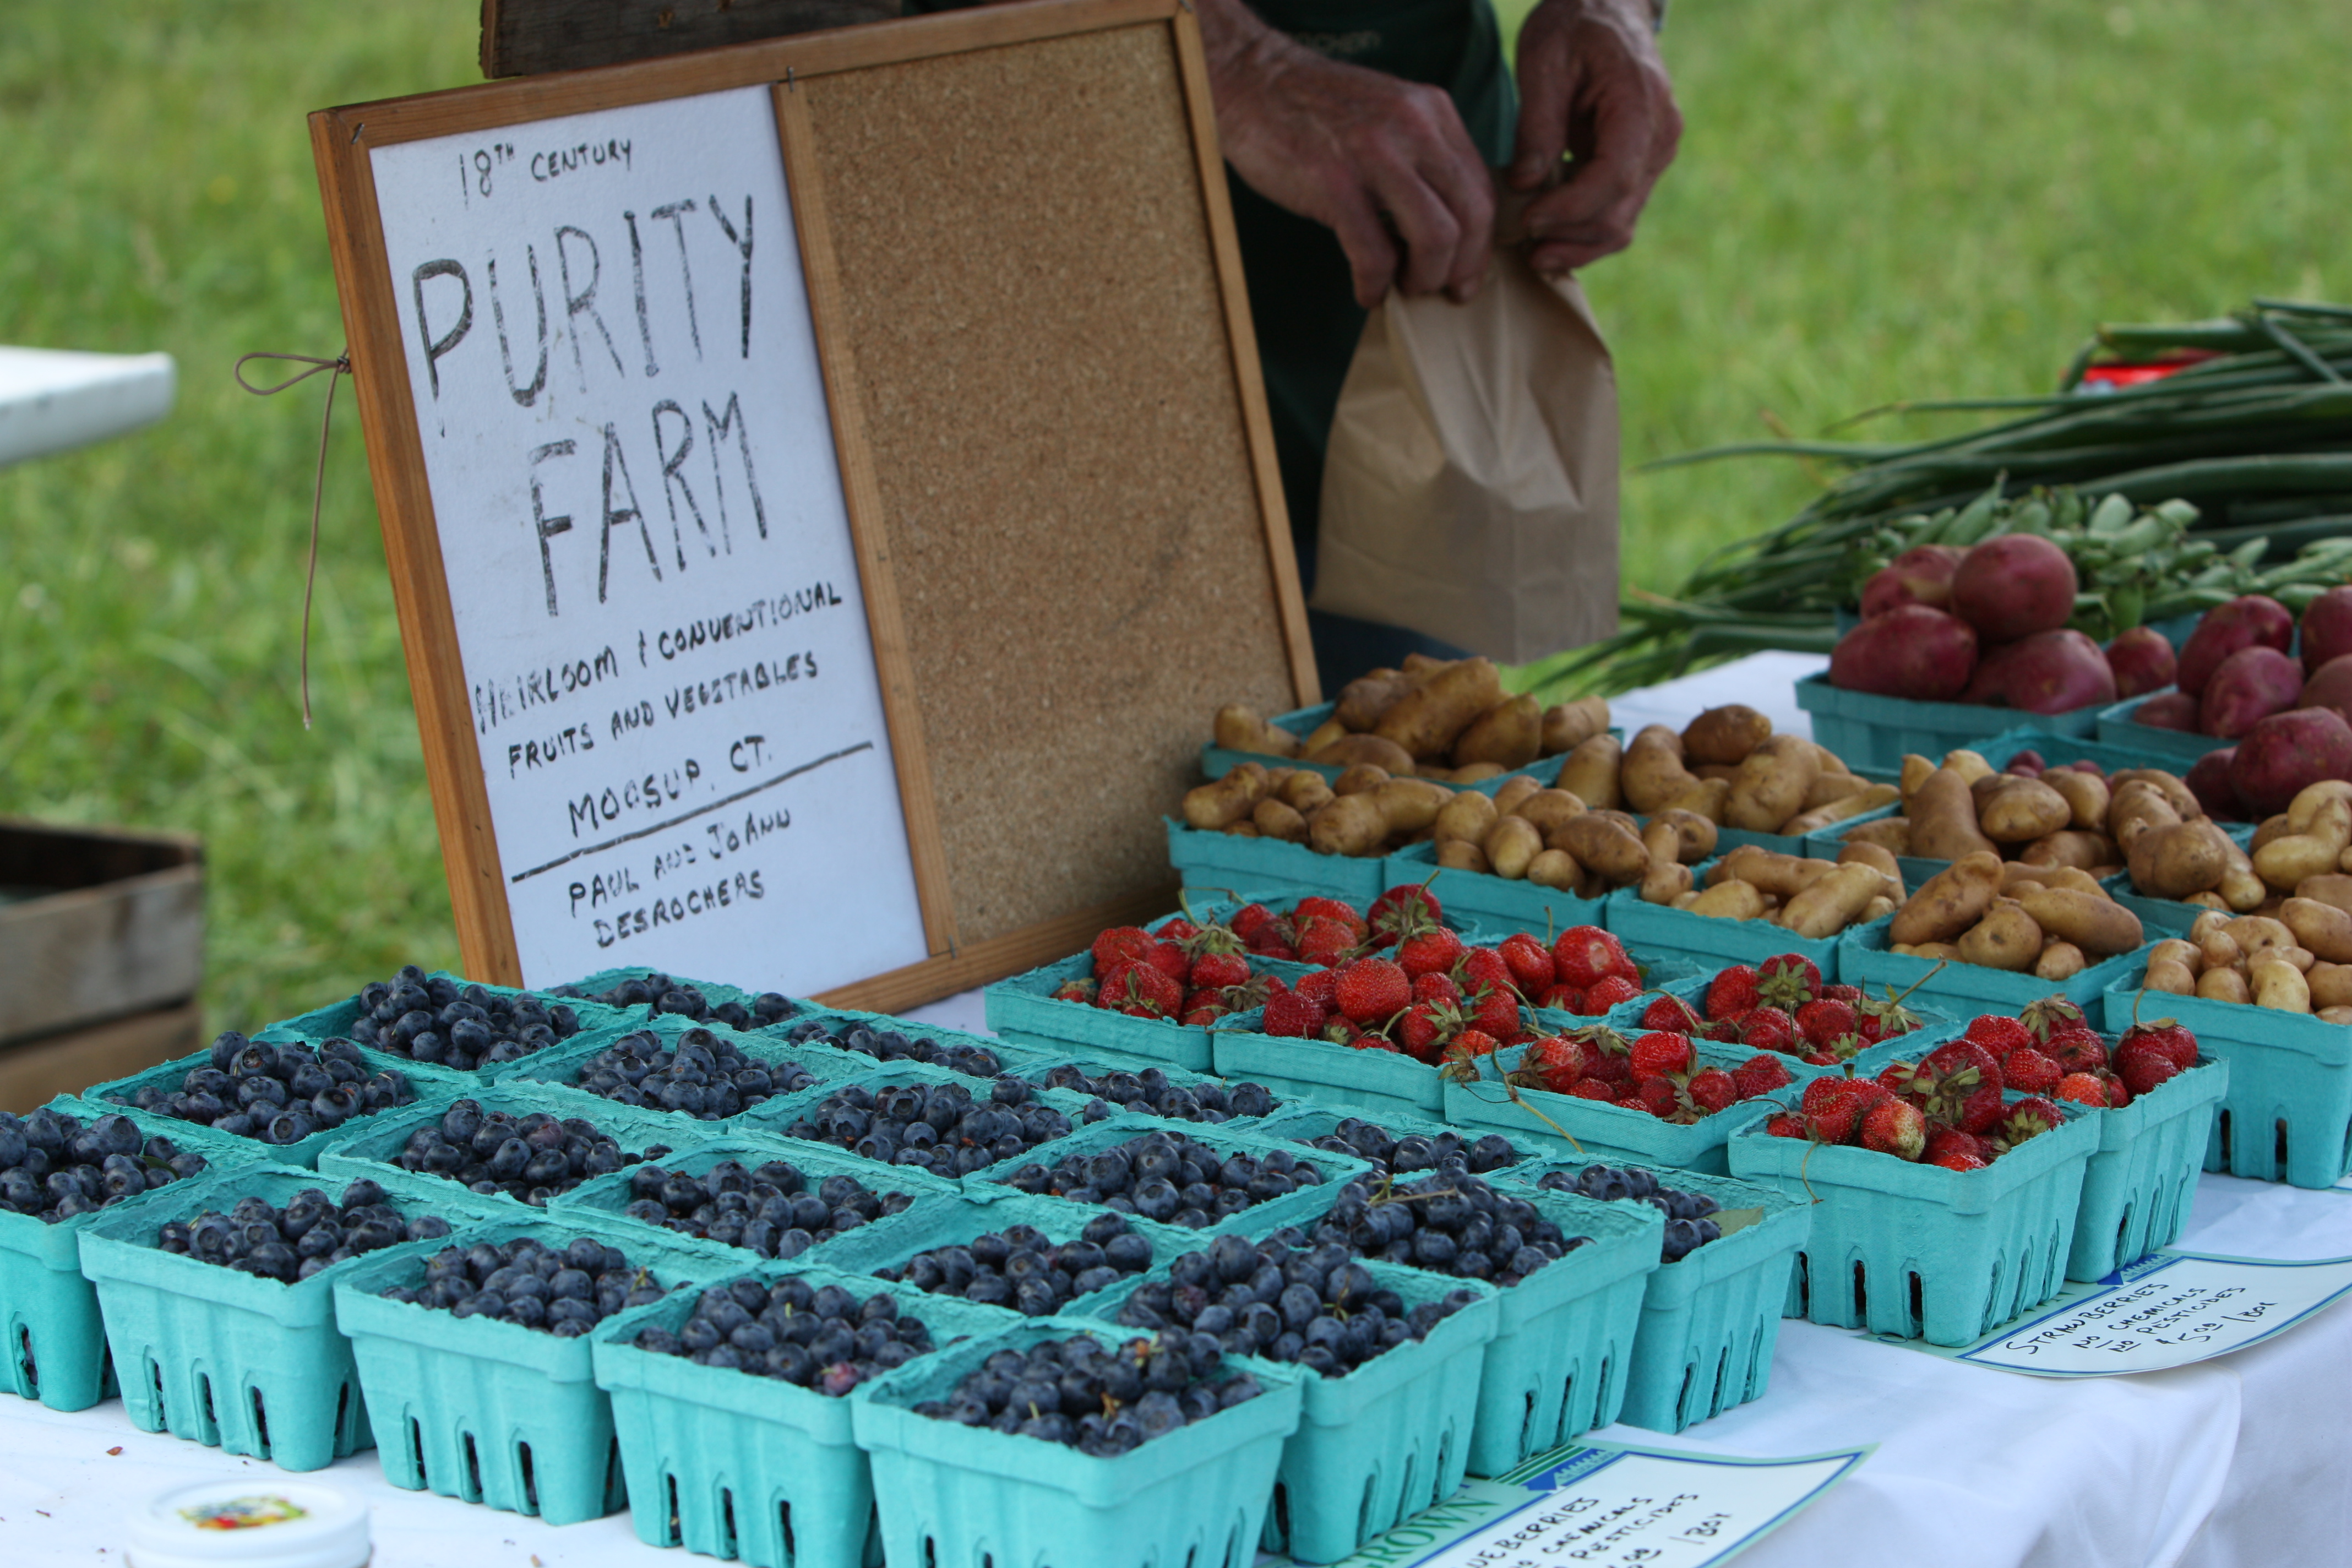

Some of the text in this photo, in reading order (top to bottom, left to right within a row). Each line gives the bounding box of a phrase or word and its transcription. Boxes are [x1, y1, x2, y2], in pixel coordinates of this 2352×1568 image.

[460, 139, 633, 210] 18TH CENTURY
[412, 194, 753, 407] PURITY
[529, 390, 768, 617] FARM
[475, 644, 618, 736] HEIRLOOM
[658, 580, 842, 661] CONVENTIONAL
[509, 650, 818, 780] FRUITS AND VEGETABLES
[569, 867, 640, 918] PAUL
[654, 843, 696, 880] AND
[593, 869, 765, 948] DESROCHERS
[2005, 1283, 2170, 1355] STRAWBERRIES
[2072, 1336, 2100, 1349] NO
[2107, 1288, 2208, 1330] CHEMICALS
[2108, 1287, 2246, 1353] NO PESTICIDES
[1332, 1494, 1503, 1568] ROWN
[1464, 1496, 1600, 1568] UEBERRIES
[1569, 1493, 1698, 1560] PESTICIDES
